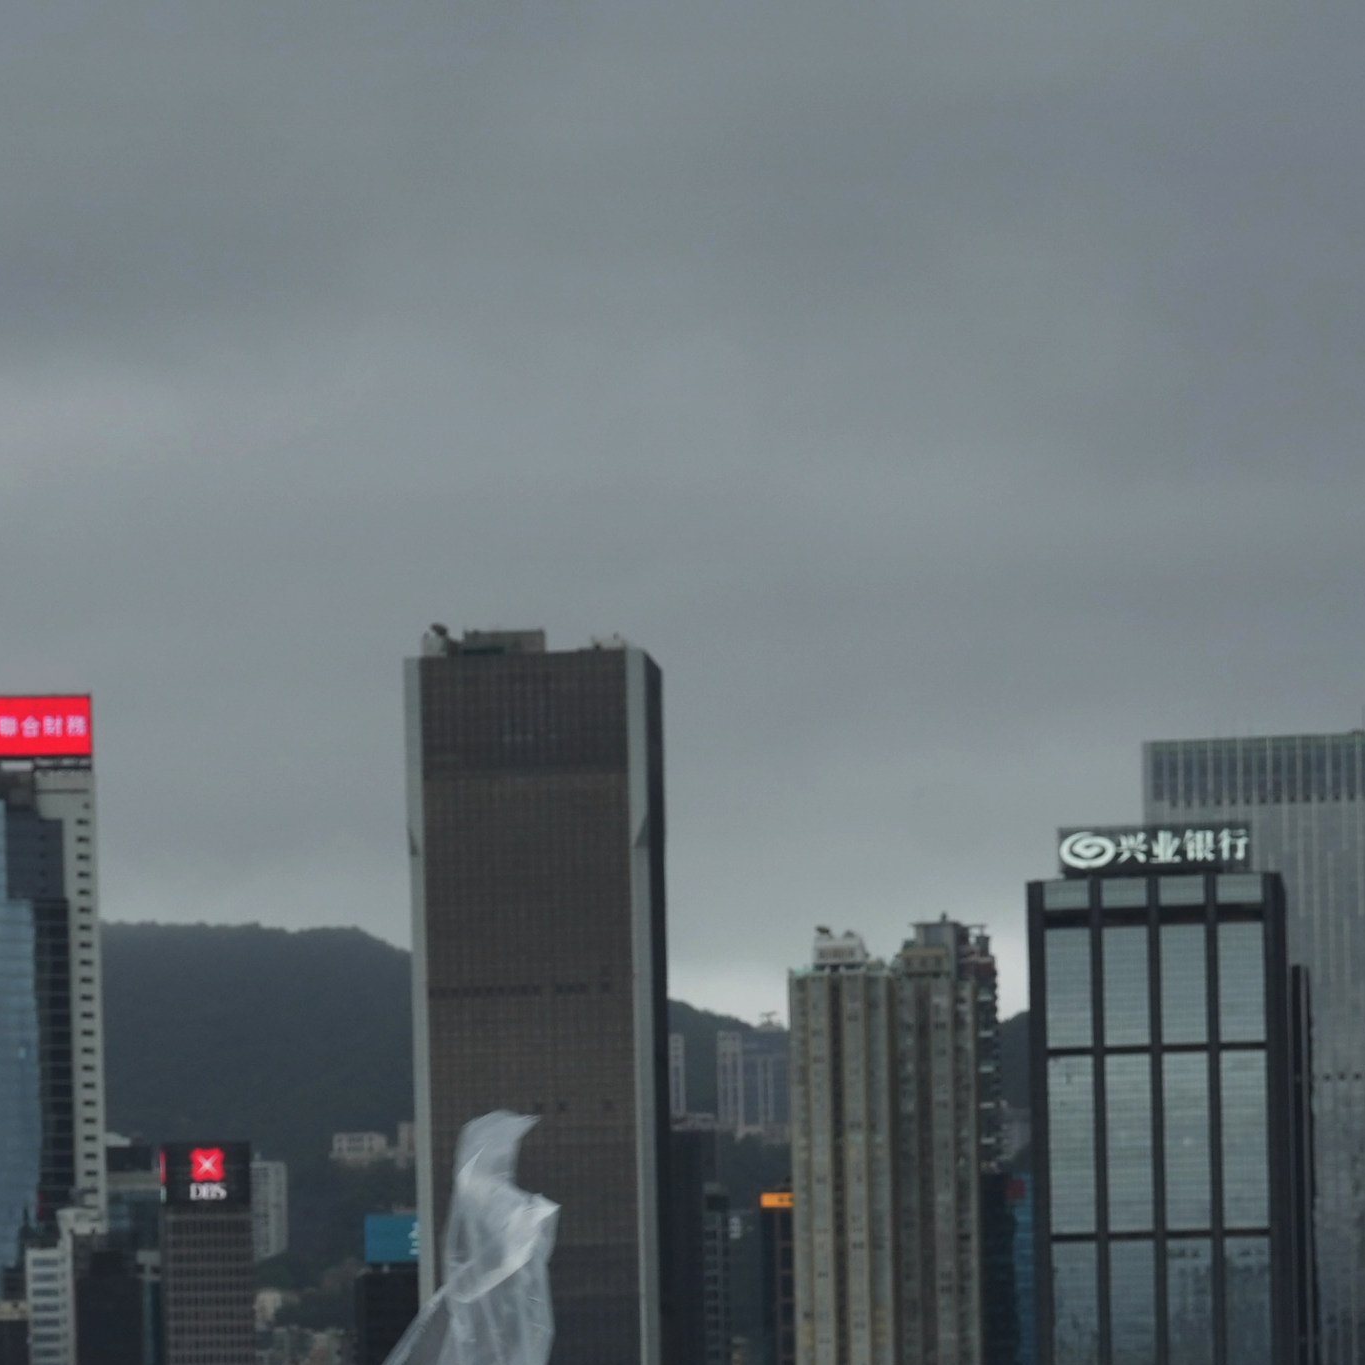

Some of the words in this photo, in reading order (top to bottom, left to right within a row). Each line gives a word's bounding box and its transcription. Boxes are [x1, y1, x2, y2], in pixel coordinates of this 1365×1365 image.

[1116, 827, 1250, 864] 兴业银行
[189, 1182, 228, 1201] DBS
